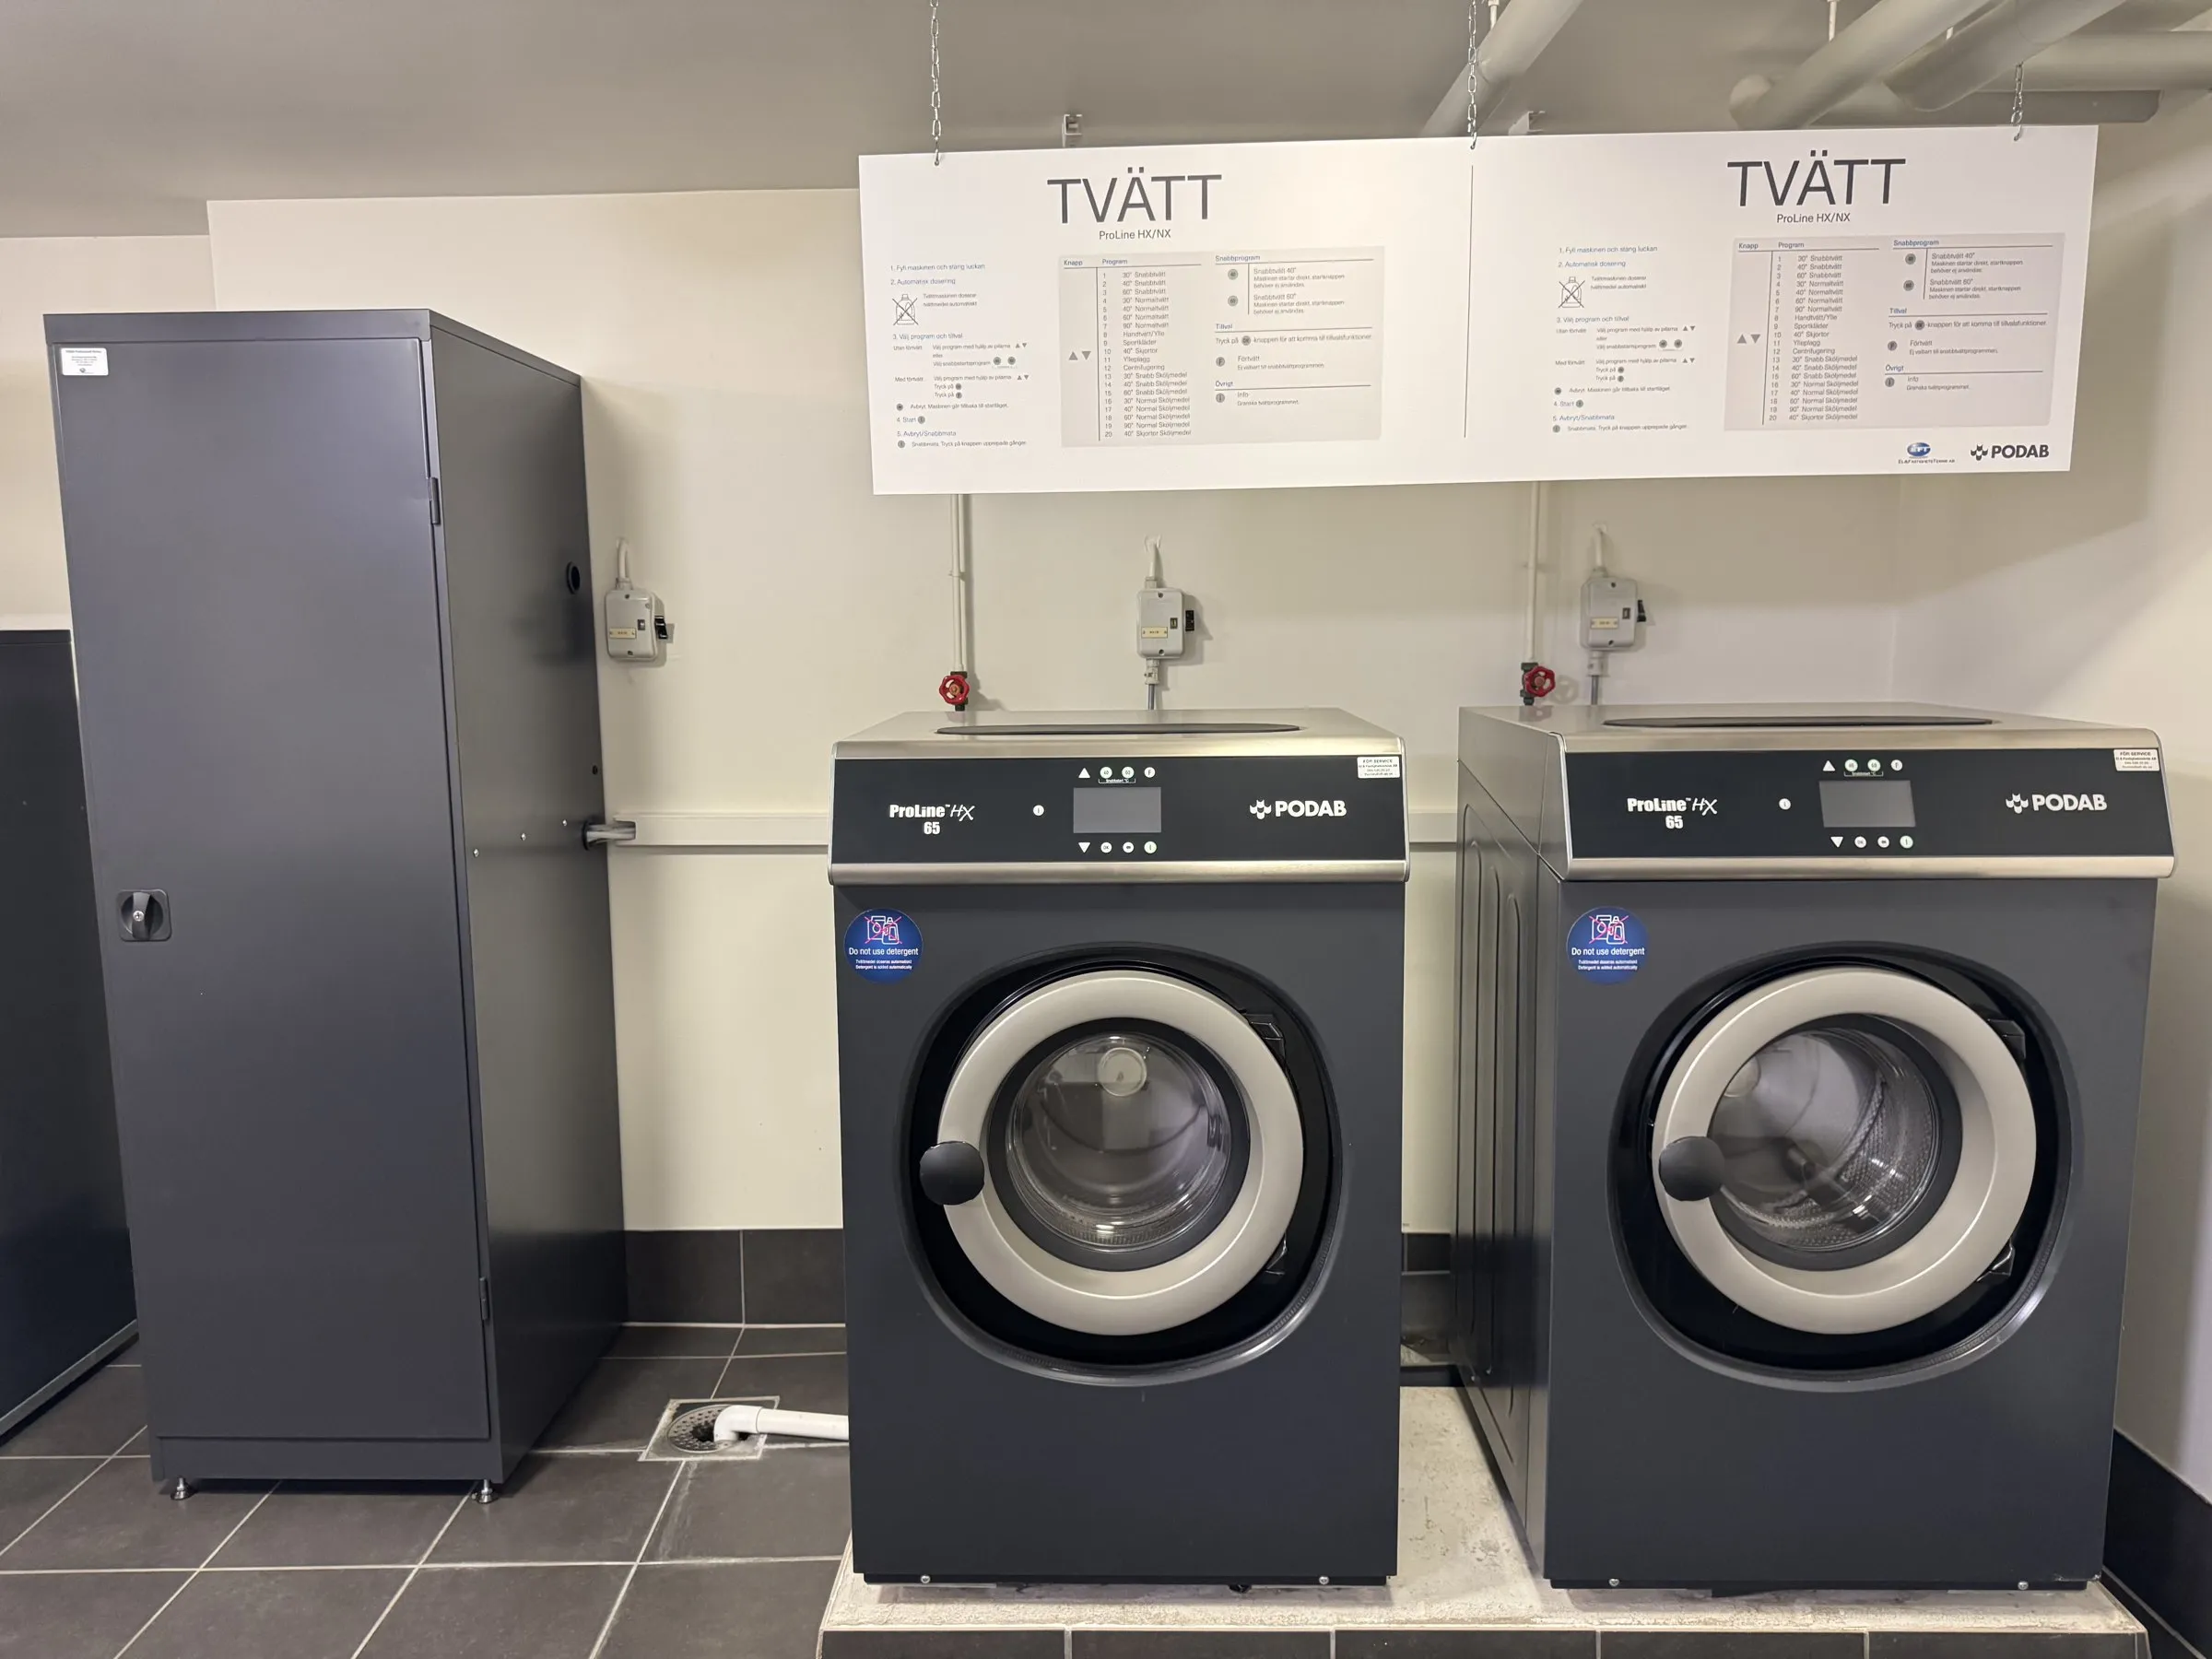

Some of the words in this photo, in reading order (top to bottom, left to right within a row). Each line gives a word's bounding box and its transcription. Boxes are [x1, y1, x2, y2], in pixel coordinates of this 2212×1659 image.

[1727, 150, 1906, 206] TVÄTT
[1047, 167, 1222, 223] TVÄTT
[1777, 214, 1814, 223] ProLine
[1817, 213, 1850, 222] HX/NX
[1100, 230, 1135, 240] ProLine
[1138, 229, 1171, 239] HX/NX
[1991, 444, 2049, 459] PODAB
[1276, 800, 1347, 817] PODAB
[1692, 797, 1717, 816] HX
[2031, 794, 2107, 811] PODAB
[950, 805, 975, 821] HX
[924, 821, 940, 834] 65
[1665, 816, 1683, 829] 65
[887, 947, 919, 956] detergent
[1611, 947, 1644, 956] detergent
